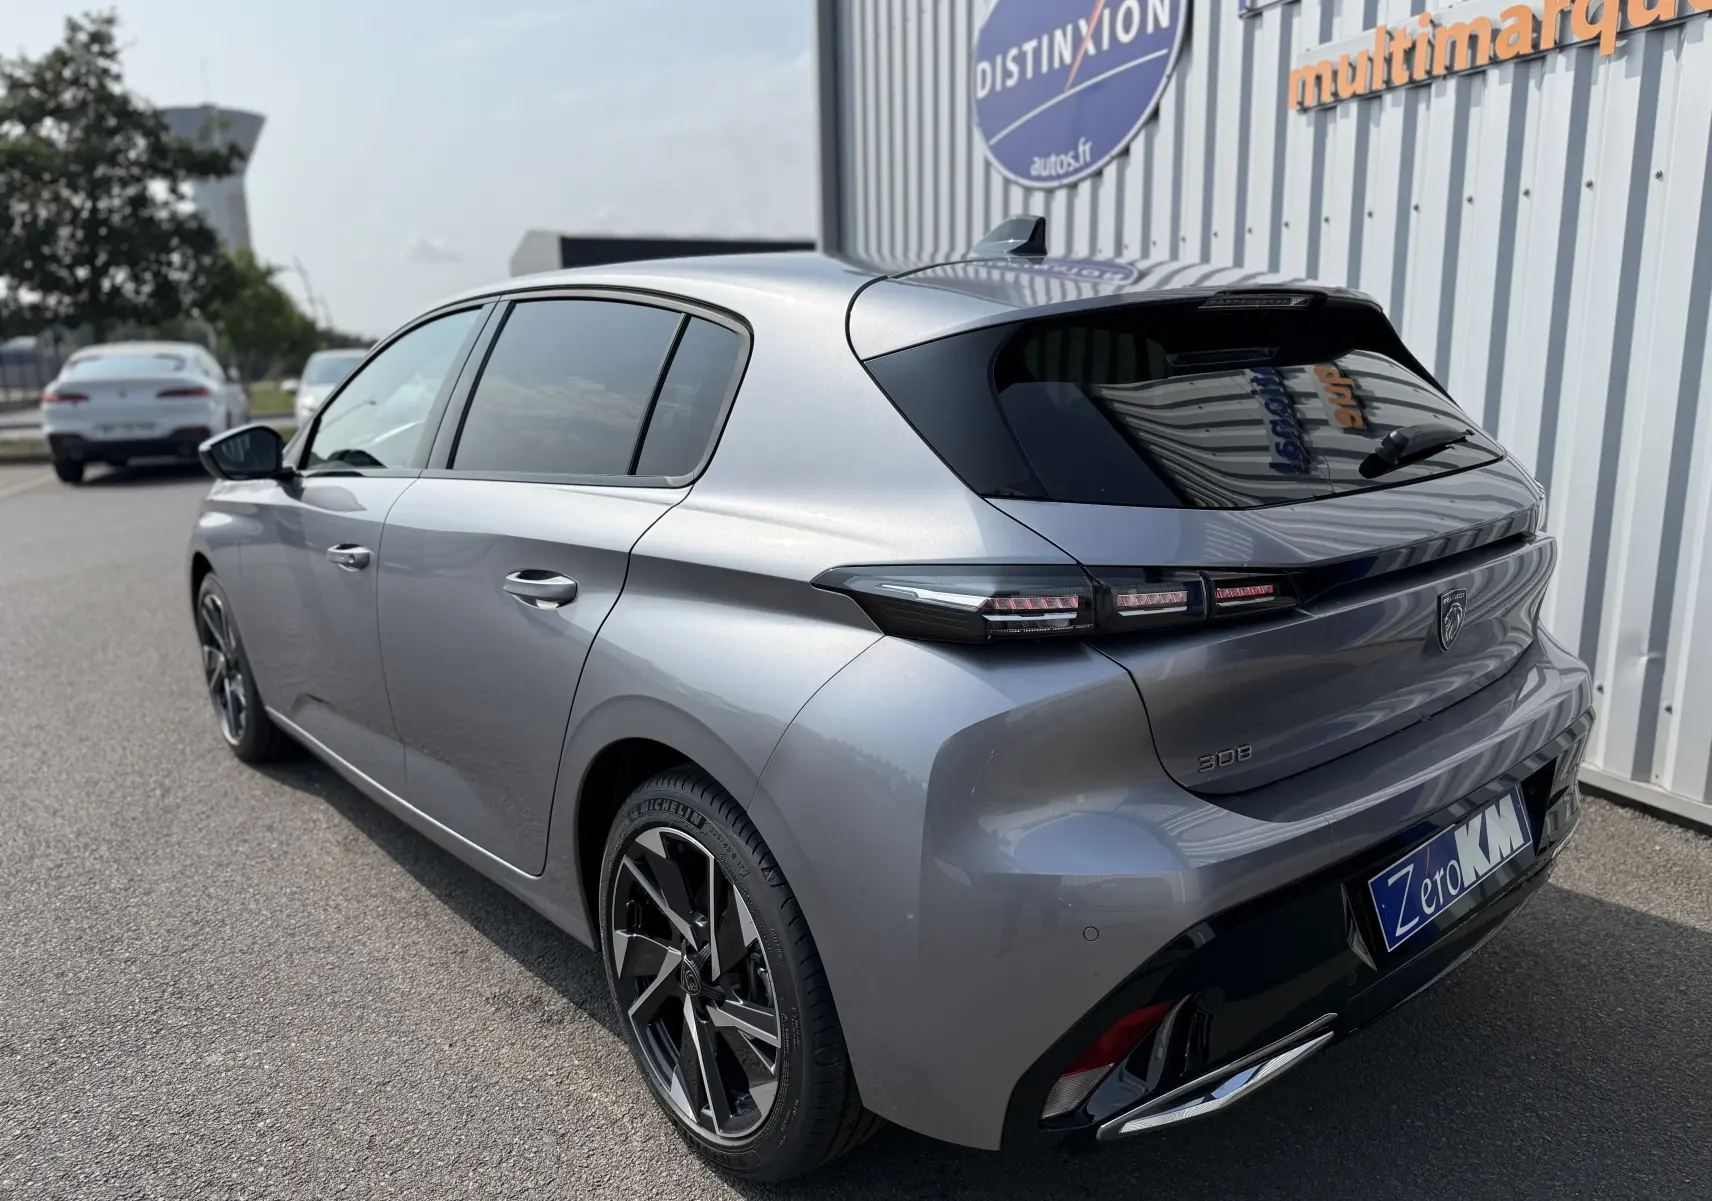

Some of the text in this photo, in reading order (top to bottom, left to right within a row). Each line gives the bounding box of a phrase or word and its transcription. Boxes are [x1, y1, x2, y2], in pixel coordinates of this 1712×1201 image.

[976, 0, 1171, 99] DISTINXION
[1288, 0, 1712, 110] multimarq
[1030, 137, 1093, 177] autos.fr
[1198, 743, 1253, 774] 308
[639, 798, 703, 827] MICHELIN
